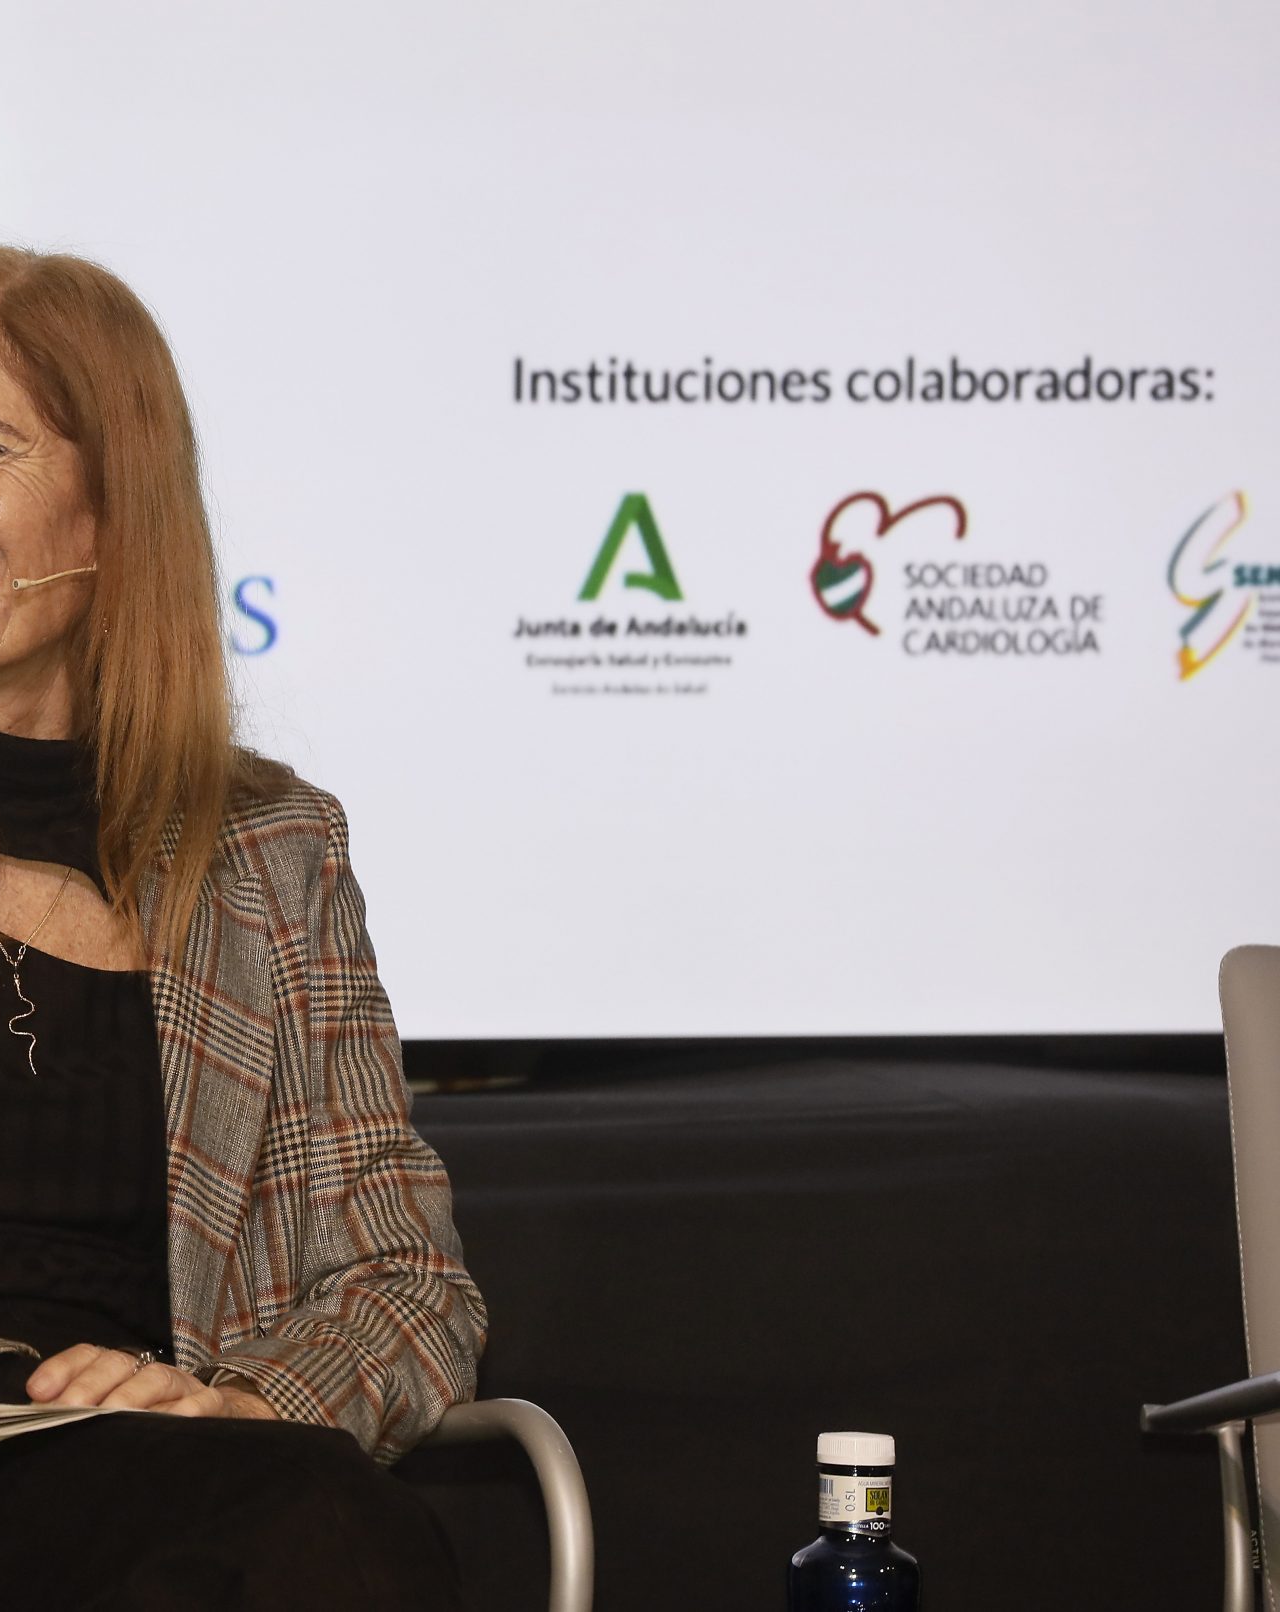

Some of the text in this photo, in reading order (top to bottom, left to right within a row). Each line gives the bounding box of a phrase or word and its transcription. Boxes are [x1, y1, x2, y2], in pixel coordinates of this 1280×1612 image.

[513, 356, 1216, 404] Instituciones colaboradoras:
[904, 562, 1049, 590] SOCIEDAD
[904, 594, 1103, 622] ANDALUZA DE
[514, 612, 748, 638] Junta de Andalucía
[902, 620, 1101, 656] CARDIOLOGÍA
[870, 1521, 885, 1531] 100
